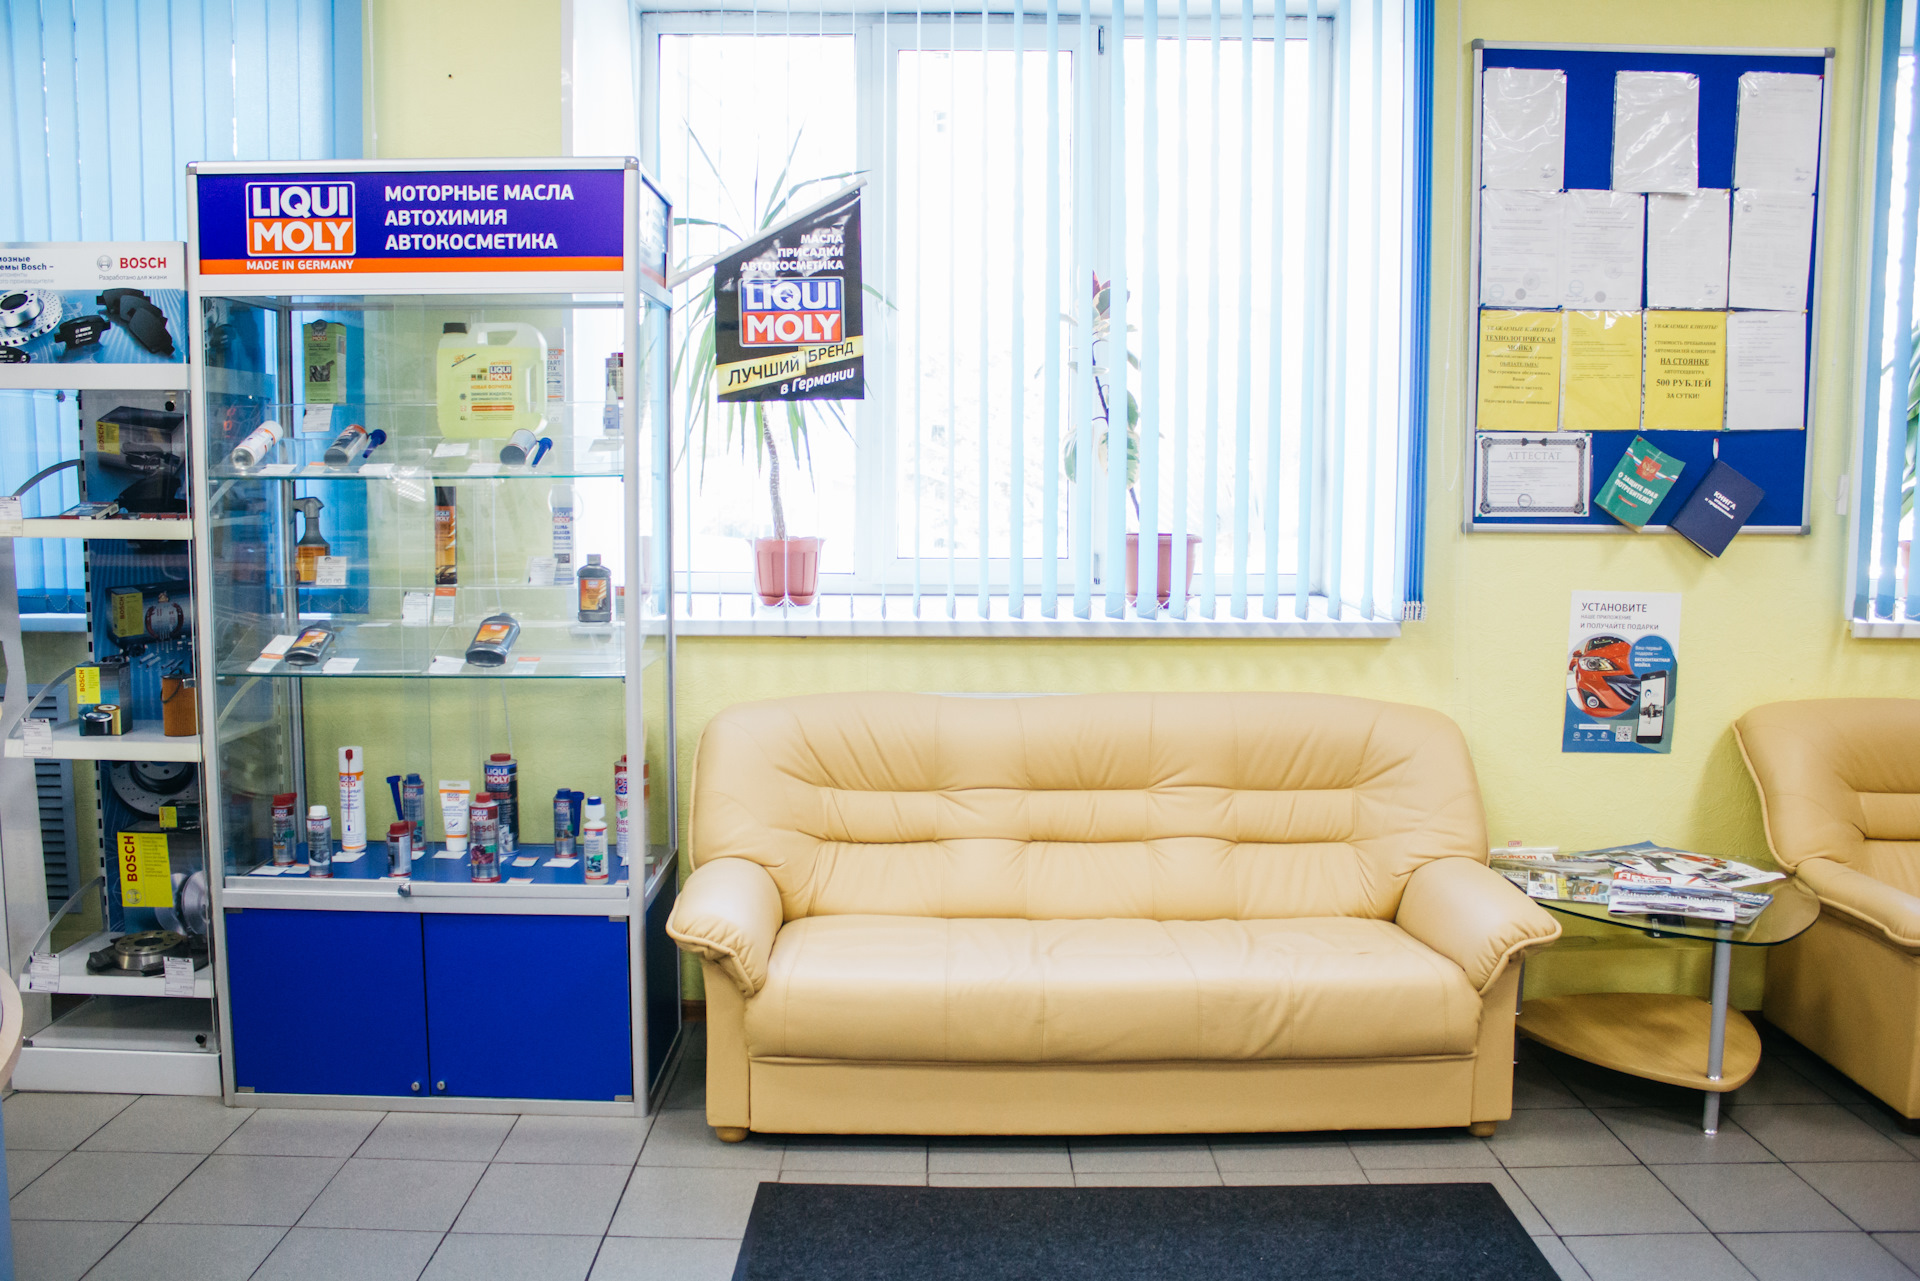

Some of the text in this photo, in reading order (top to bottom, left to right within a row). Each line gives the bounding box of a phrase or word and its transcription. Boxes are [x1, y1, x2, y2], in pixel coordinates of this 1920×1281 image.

[385, 184, 574, 202] МОТОРНЫЕ МАСЛА
[252, 186, 349, 218] LIQUI
[385, 210, 508, 226] АВТОХИМИЯ
[254, 221, 352, 251] MOLY
[385, 234, 558, 250] АВТОКОСМЕТИКА
[801, 234, 843, 244] МАСЛА
[778, 247, 844, 258] ПРИСАДКИ
[120, 257, 167, 269] BOSCH
[246, 260, 354, 270] MADE IN GERMANY
[740, 261, 844, 272] АВТОКОСМЕТИКА
[746, 281, 836, 311] LIQUI
[746, 314, 840, 342] MOLY
[728, 341, 854, 386] ЛУЧШИЙ БРЕНД
[780, 368, 855, 395] в Германии
[1673, 378, 1711, 387] РУБЛЕЙ
[1507, 452, 1562, 460] АТТЕСТАТ
[1714, 490, 1736, 510] КНИГА
[1582, 603, 1647, 612] УСТАНОВИТЕ
[470, 822, 495, 832] Diesel
[123, 836, 137, 882] BOSCH
